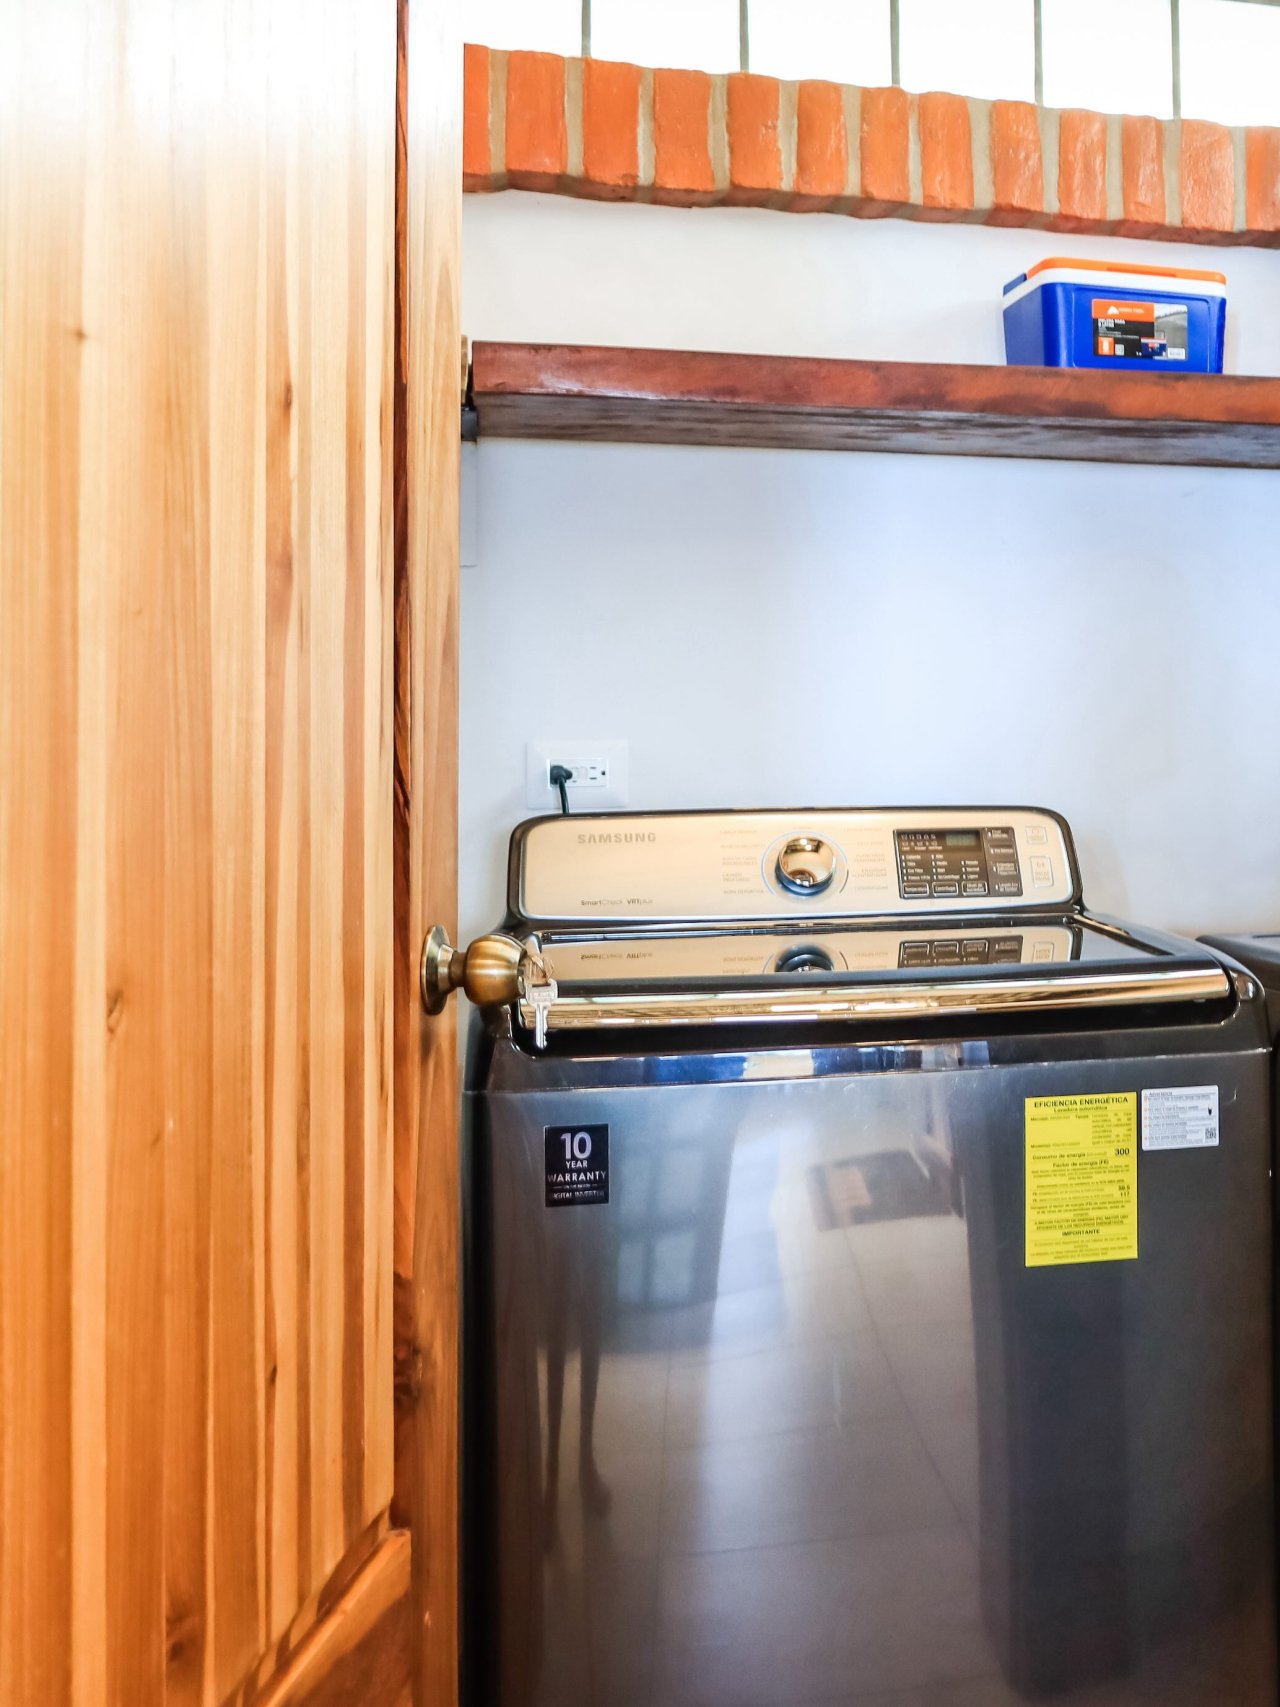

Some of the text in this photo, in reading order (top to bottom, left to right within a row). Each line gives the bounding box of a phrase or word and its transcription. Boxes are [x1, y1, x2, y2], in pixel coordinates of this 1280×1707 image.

[577, 832, 656, 844] SAMSUNG
[1034, 1096, 1128, 1108] EFICIENCIA ENERGÉTICA
[560, 1131, 592, 1159] 10
[1115, 1148, 1129, 1156] 300
[566, 1160, 587, 1169] YEAR
[547, 1170, 606, 1183] WARRANTY
